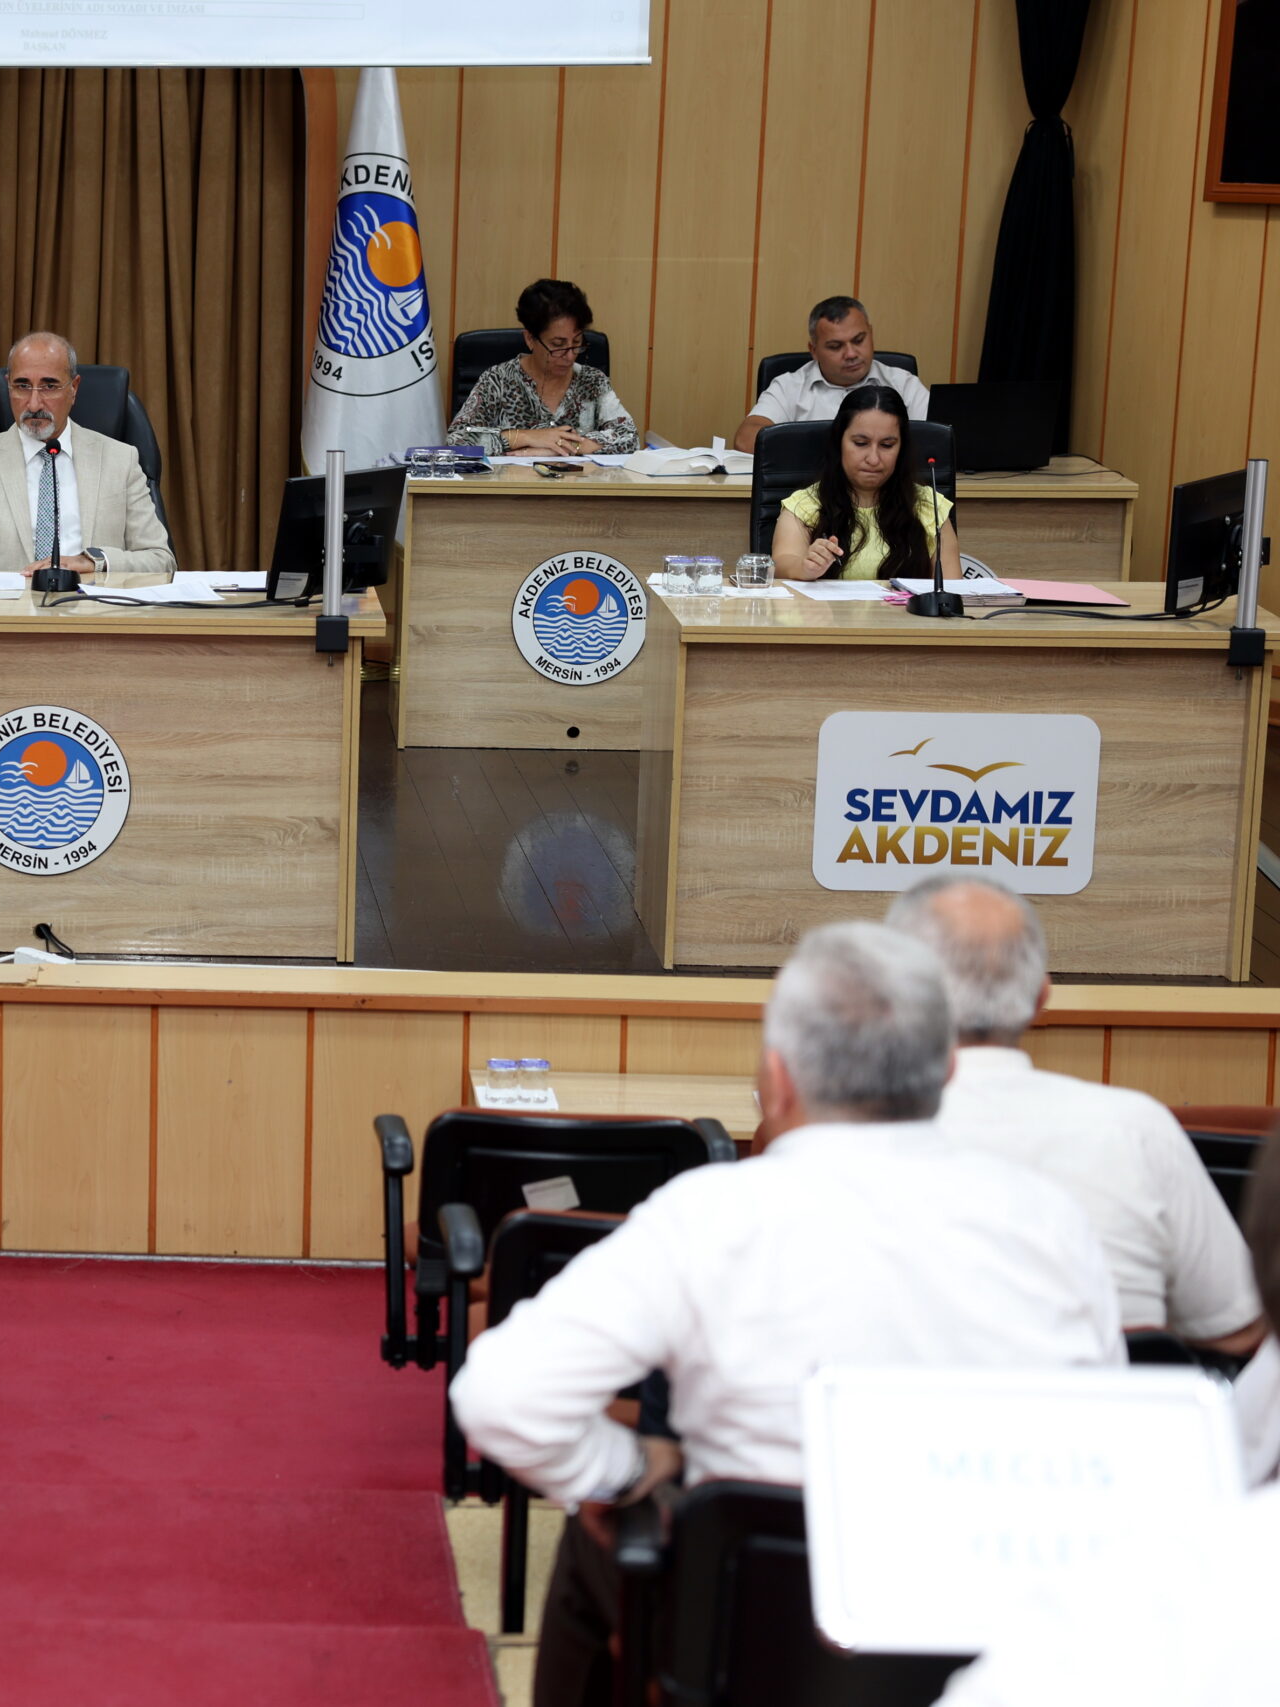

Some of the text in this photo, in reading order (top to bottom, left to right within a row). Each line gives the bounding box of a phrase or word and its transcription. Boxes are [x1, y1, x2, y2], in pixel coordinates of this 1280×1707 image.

[518, 556, 647, 621] AKDENİZ BELEDİYESİ
[534, 655, 583, 681] MERSİN
[594, 658, 622, 678] 1994
[33, 712, 127, 793] BELEDİYESİ
[844, 788, 1075, 825] SEVDAMIZ
[63, 840, 98, 866] 1994
